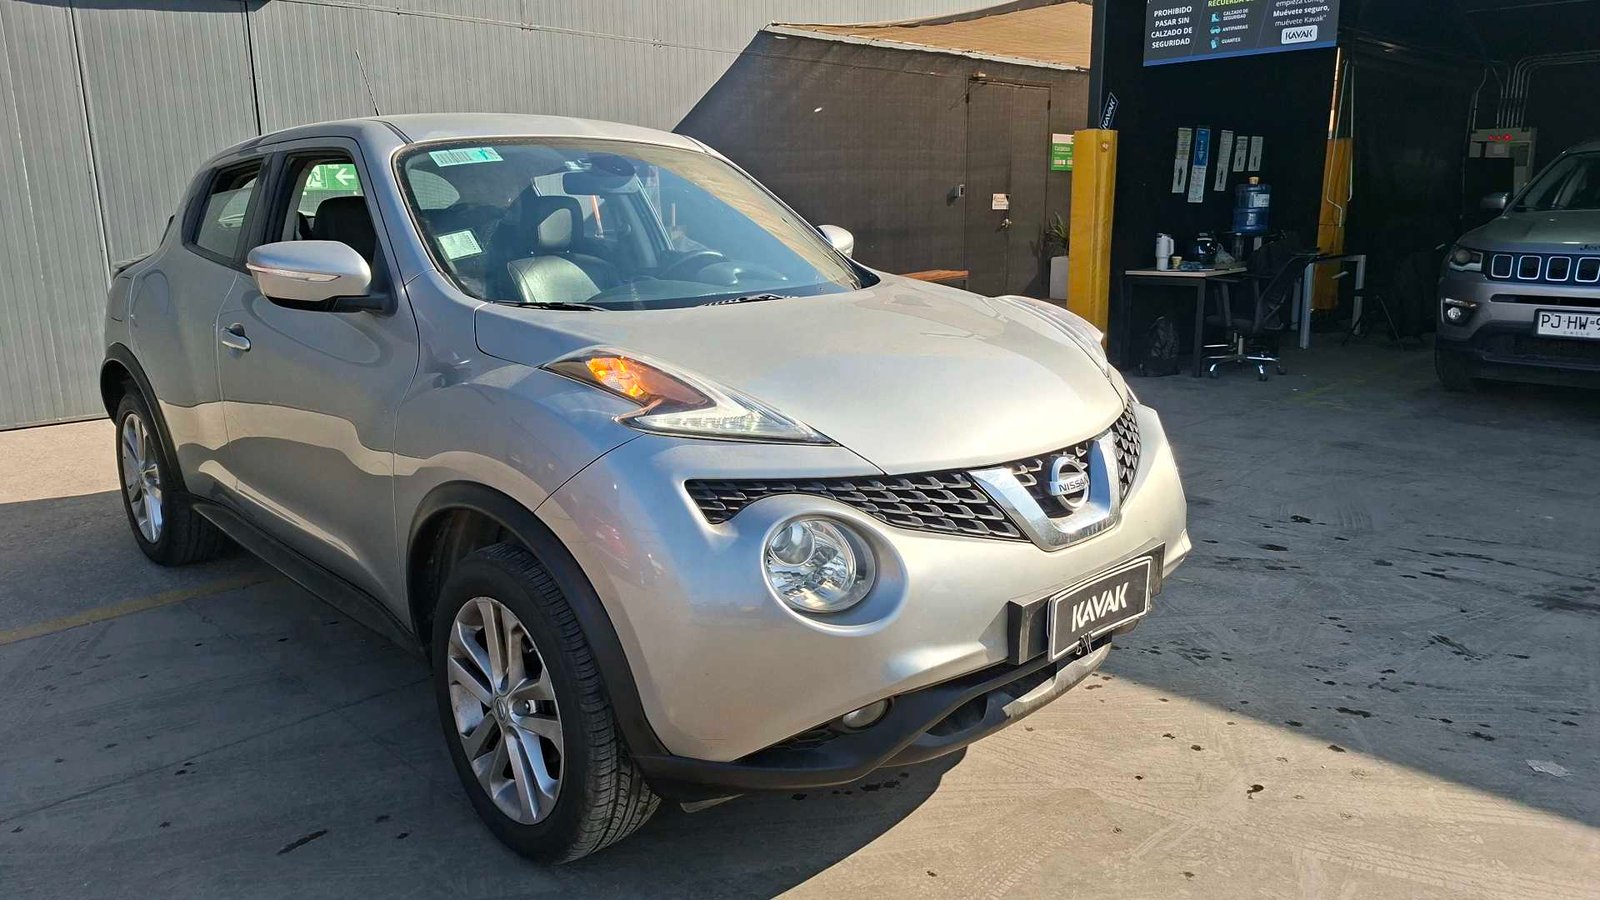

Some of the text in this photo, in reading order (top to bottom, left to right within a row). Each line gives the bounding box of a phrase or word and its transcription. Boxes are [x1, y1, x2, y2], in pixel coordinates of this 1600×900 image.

[1154, 6, 1192, 17] PROHIBIDO
[1273, 6, 1330, 17] Muévete seguro,
[1155, 17, 1190, 27] PASAR SIN
[1151, 29, 1182, 38] CALZADO
[1285, 29, 1313, 40] KAVAK
[1152, 38, 1191, 49] SEGURIDAD
[1058, 476, 1089, 492] NISSAN
[1071, 582, 1129, 632] KAVAK
